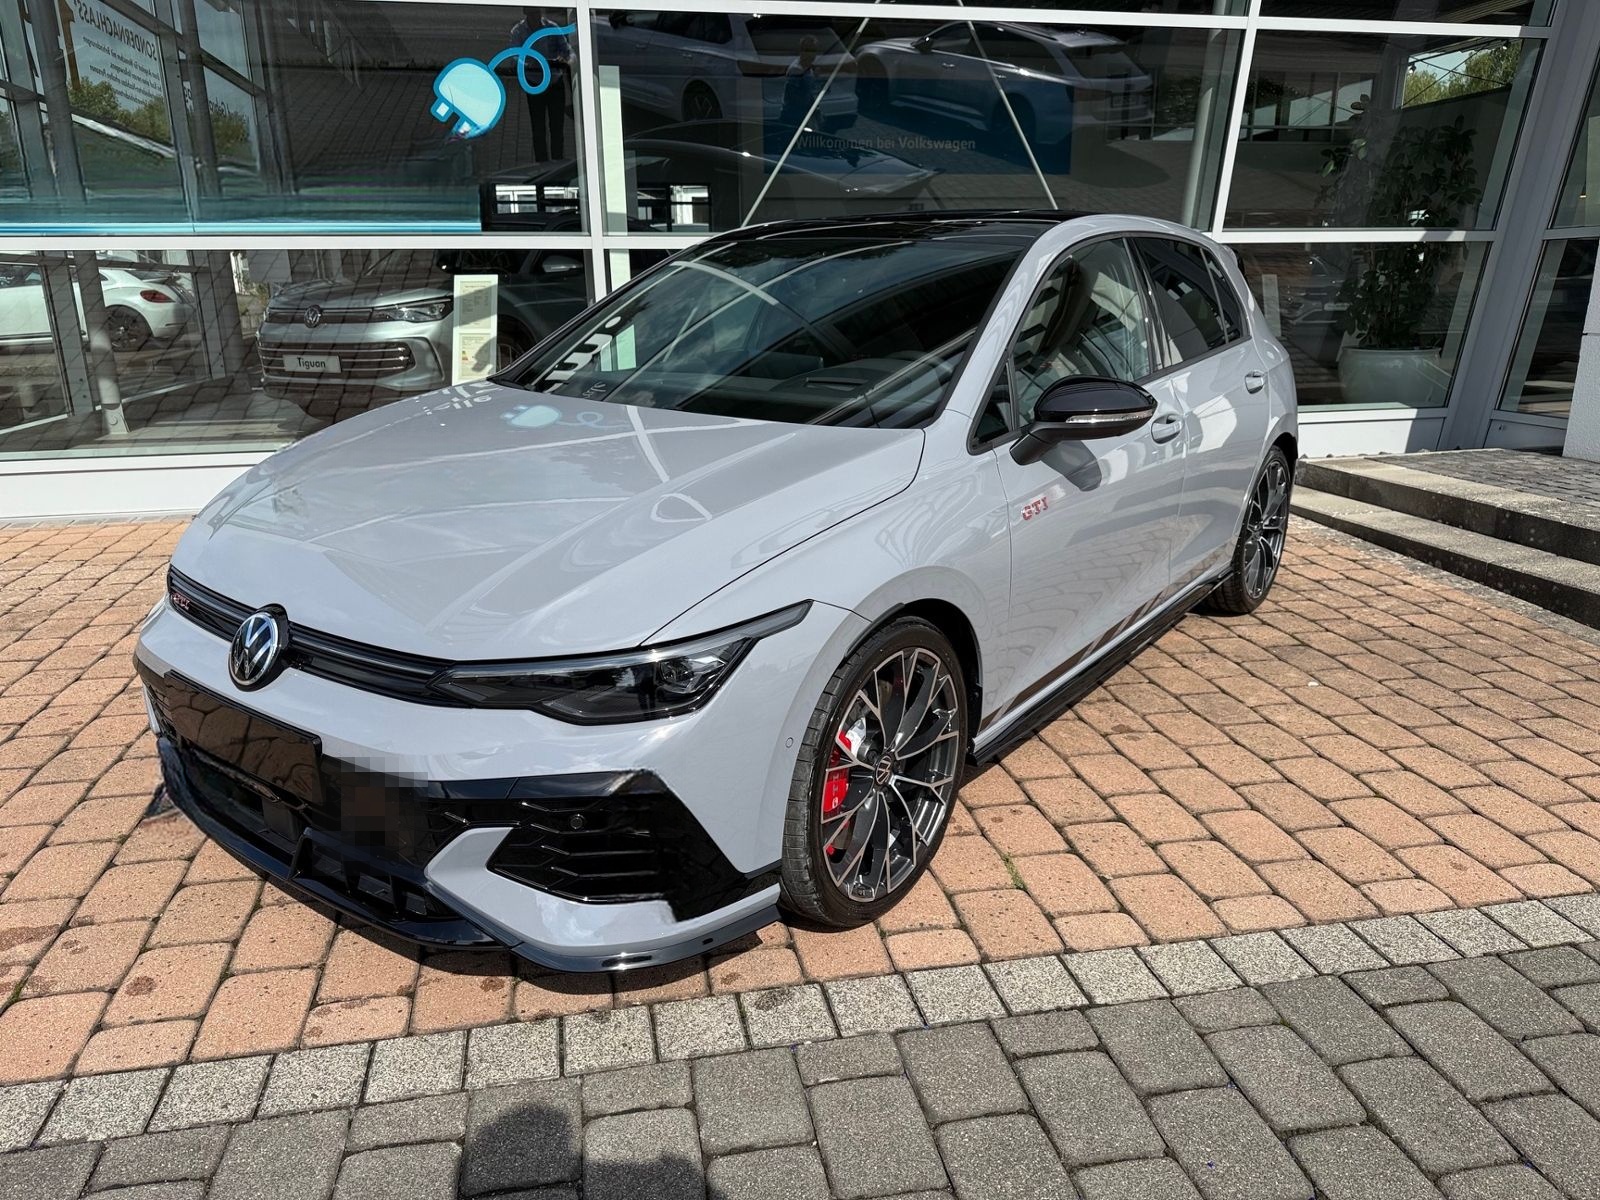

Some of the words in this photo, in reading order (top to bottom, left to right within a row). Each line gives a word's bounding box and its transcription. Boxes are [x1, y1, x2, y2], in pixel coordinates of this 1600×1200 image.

[797, 134, 873, 149] Willkommen
[876, 136, 895, 149] bei
[898, 137, 976, 152] Volkswagen
[297, 356, 326, 369] Tiguan
[1021, 496, 1049, 521] GTI
